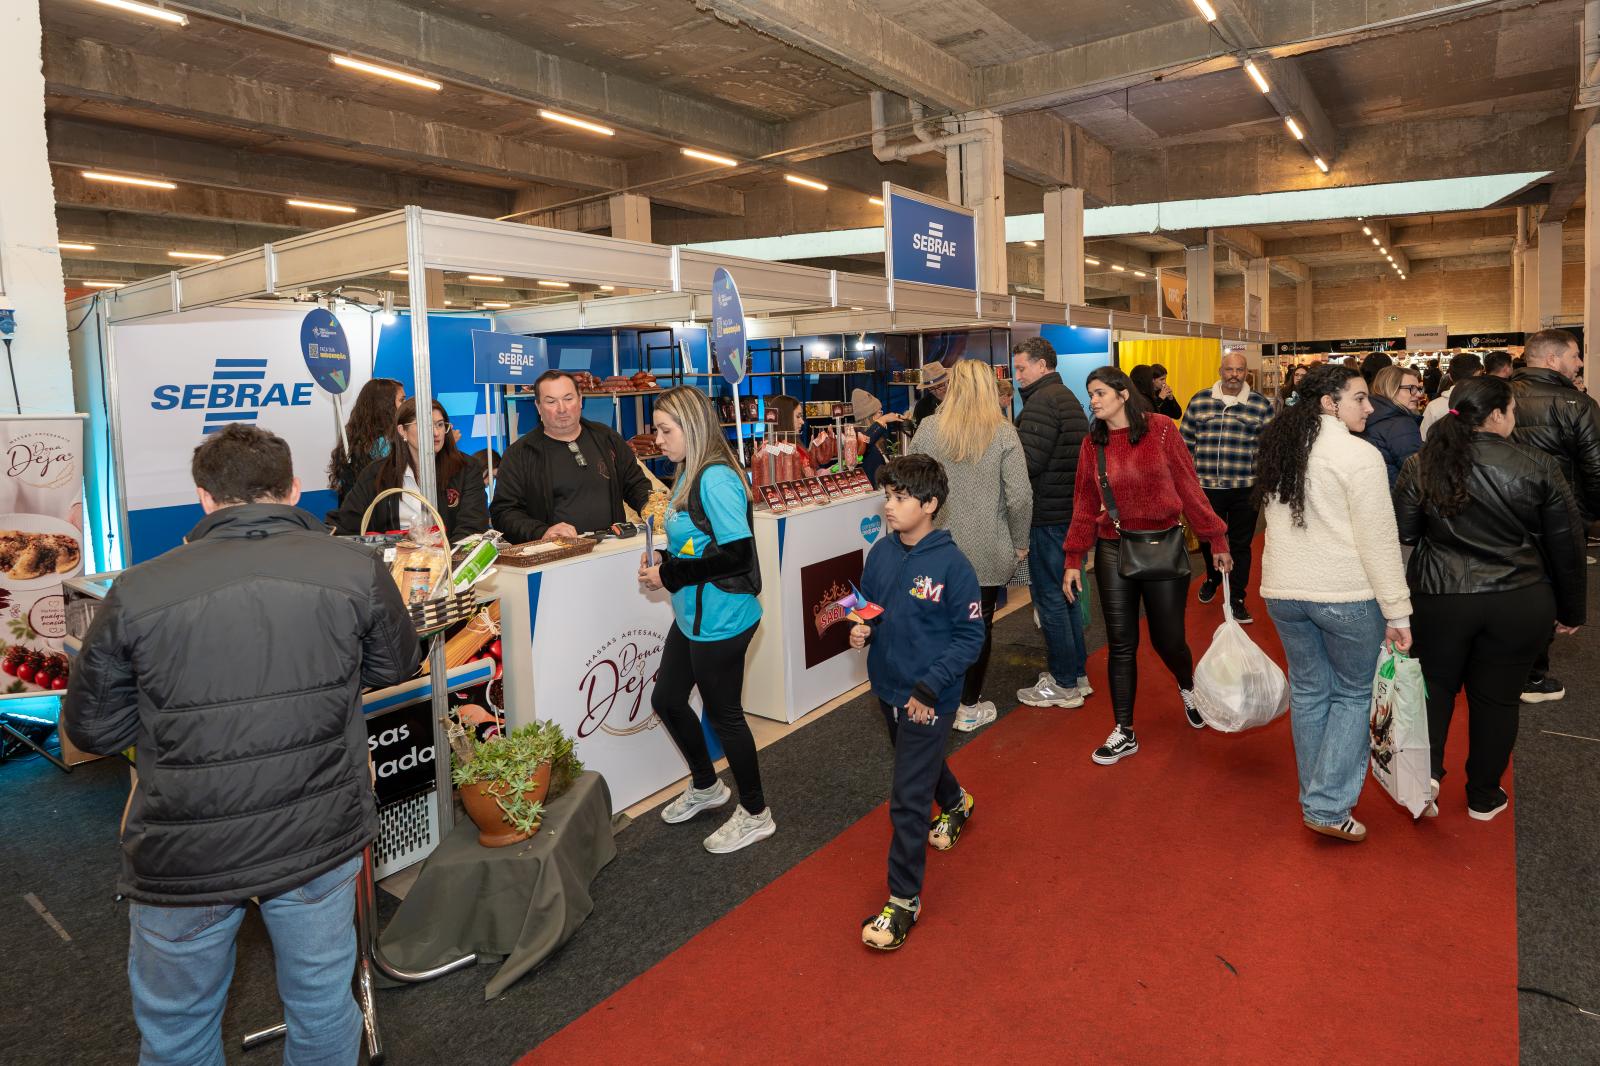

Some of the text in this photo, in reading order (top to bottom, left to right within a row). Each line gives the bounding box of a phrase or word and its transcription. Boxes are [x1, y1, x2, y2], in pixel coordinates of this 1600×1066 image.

[913, 233, 957, 257] SEBRAE
[498, 352, 534, 367] SEBRAE
[151, 382, 314, 411] SEBRAE
[585, 637, 617, 668] MASSAS
[618, 642, 664, 678] Dona
